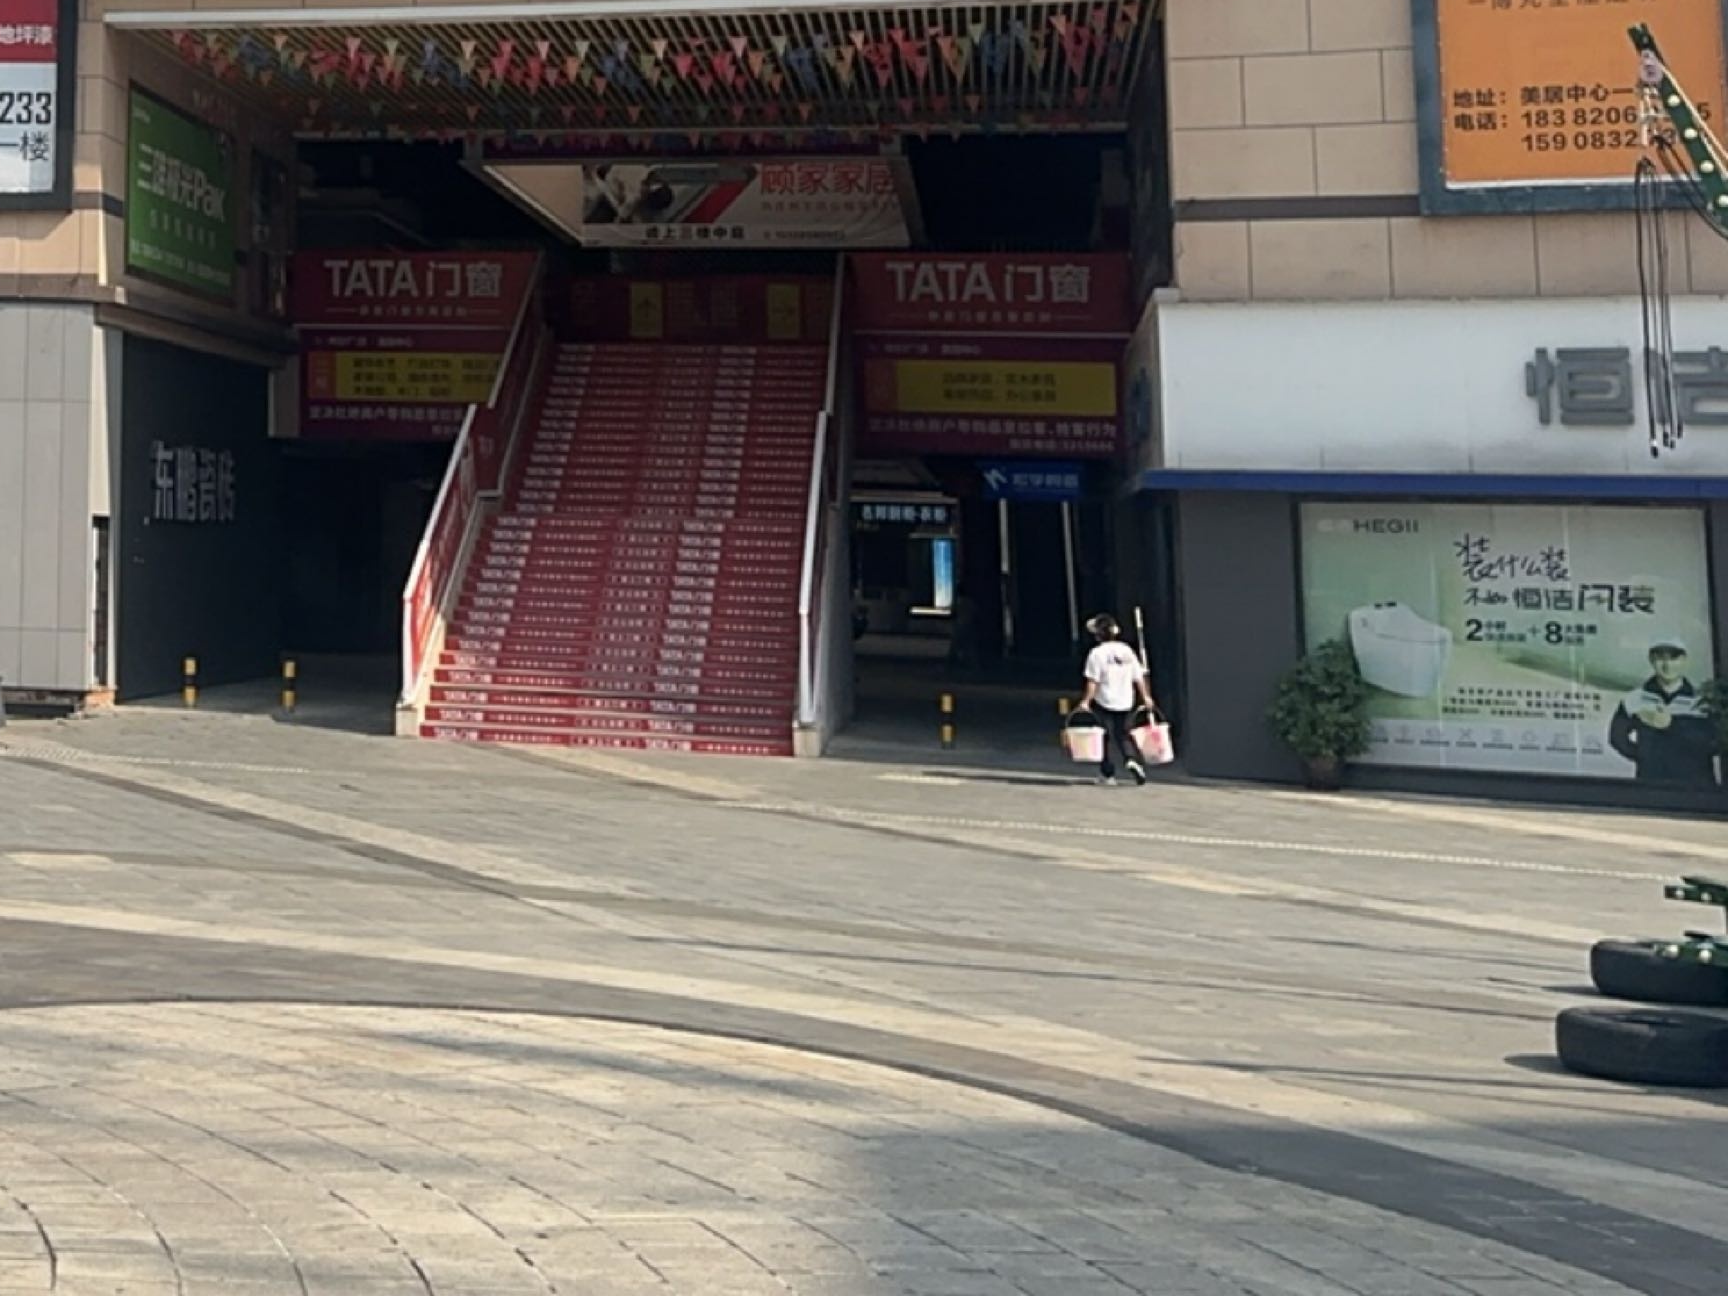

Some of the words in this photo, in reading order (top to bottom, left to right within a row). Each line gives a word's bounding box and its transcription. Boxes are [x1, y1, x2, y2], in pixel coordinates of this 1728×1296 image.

[1522, 132, 1567, 152] 159
[323, 259, 503, 299] TATA门窗
[884, 260, 1091, 304] TATA门窗
[1353, 518, 1420, 534] HEGII
[1453, 532, 1572, 583] 装什么装
